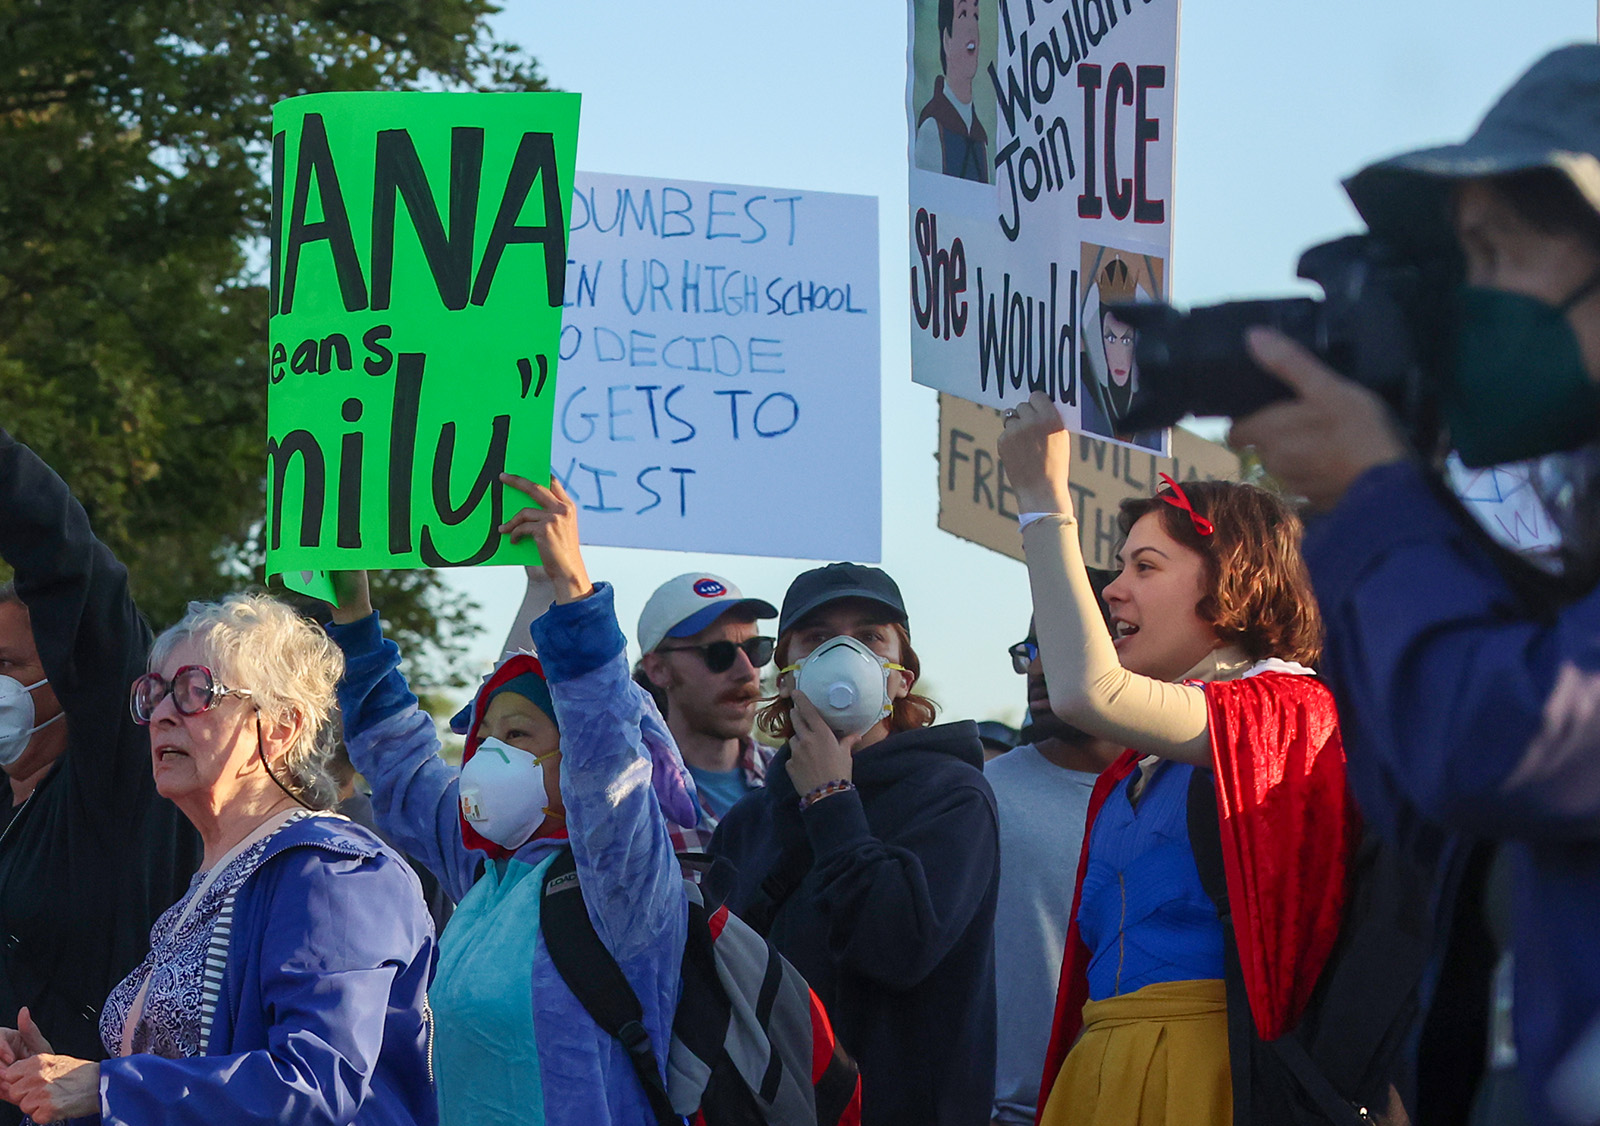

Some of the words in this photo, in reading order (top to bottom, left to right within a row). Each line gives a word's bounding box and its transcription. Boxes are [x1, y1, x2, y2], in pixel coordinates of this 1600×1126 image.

[995, 114, 1075, 241] Join
[1077, 62, 1165, 224] ICE
[621, 259, 672, 316] UR
[911, 207, 967, 340] She
[594, 328, 786, 377] DECIDE
[977, 262, 1078, 407] Would
[561, 385, 697, 443] GETS
[714, 390, 800, 440] TO
